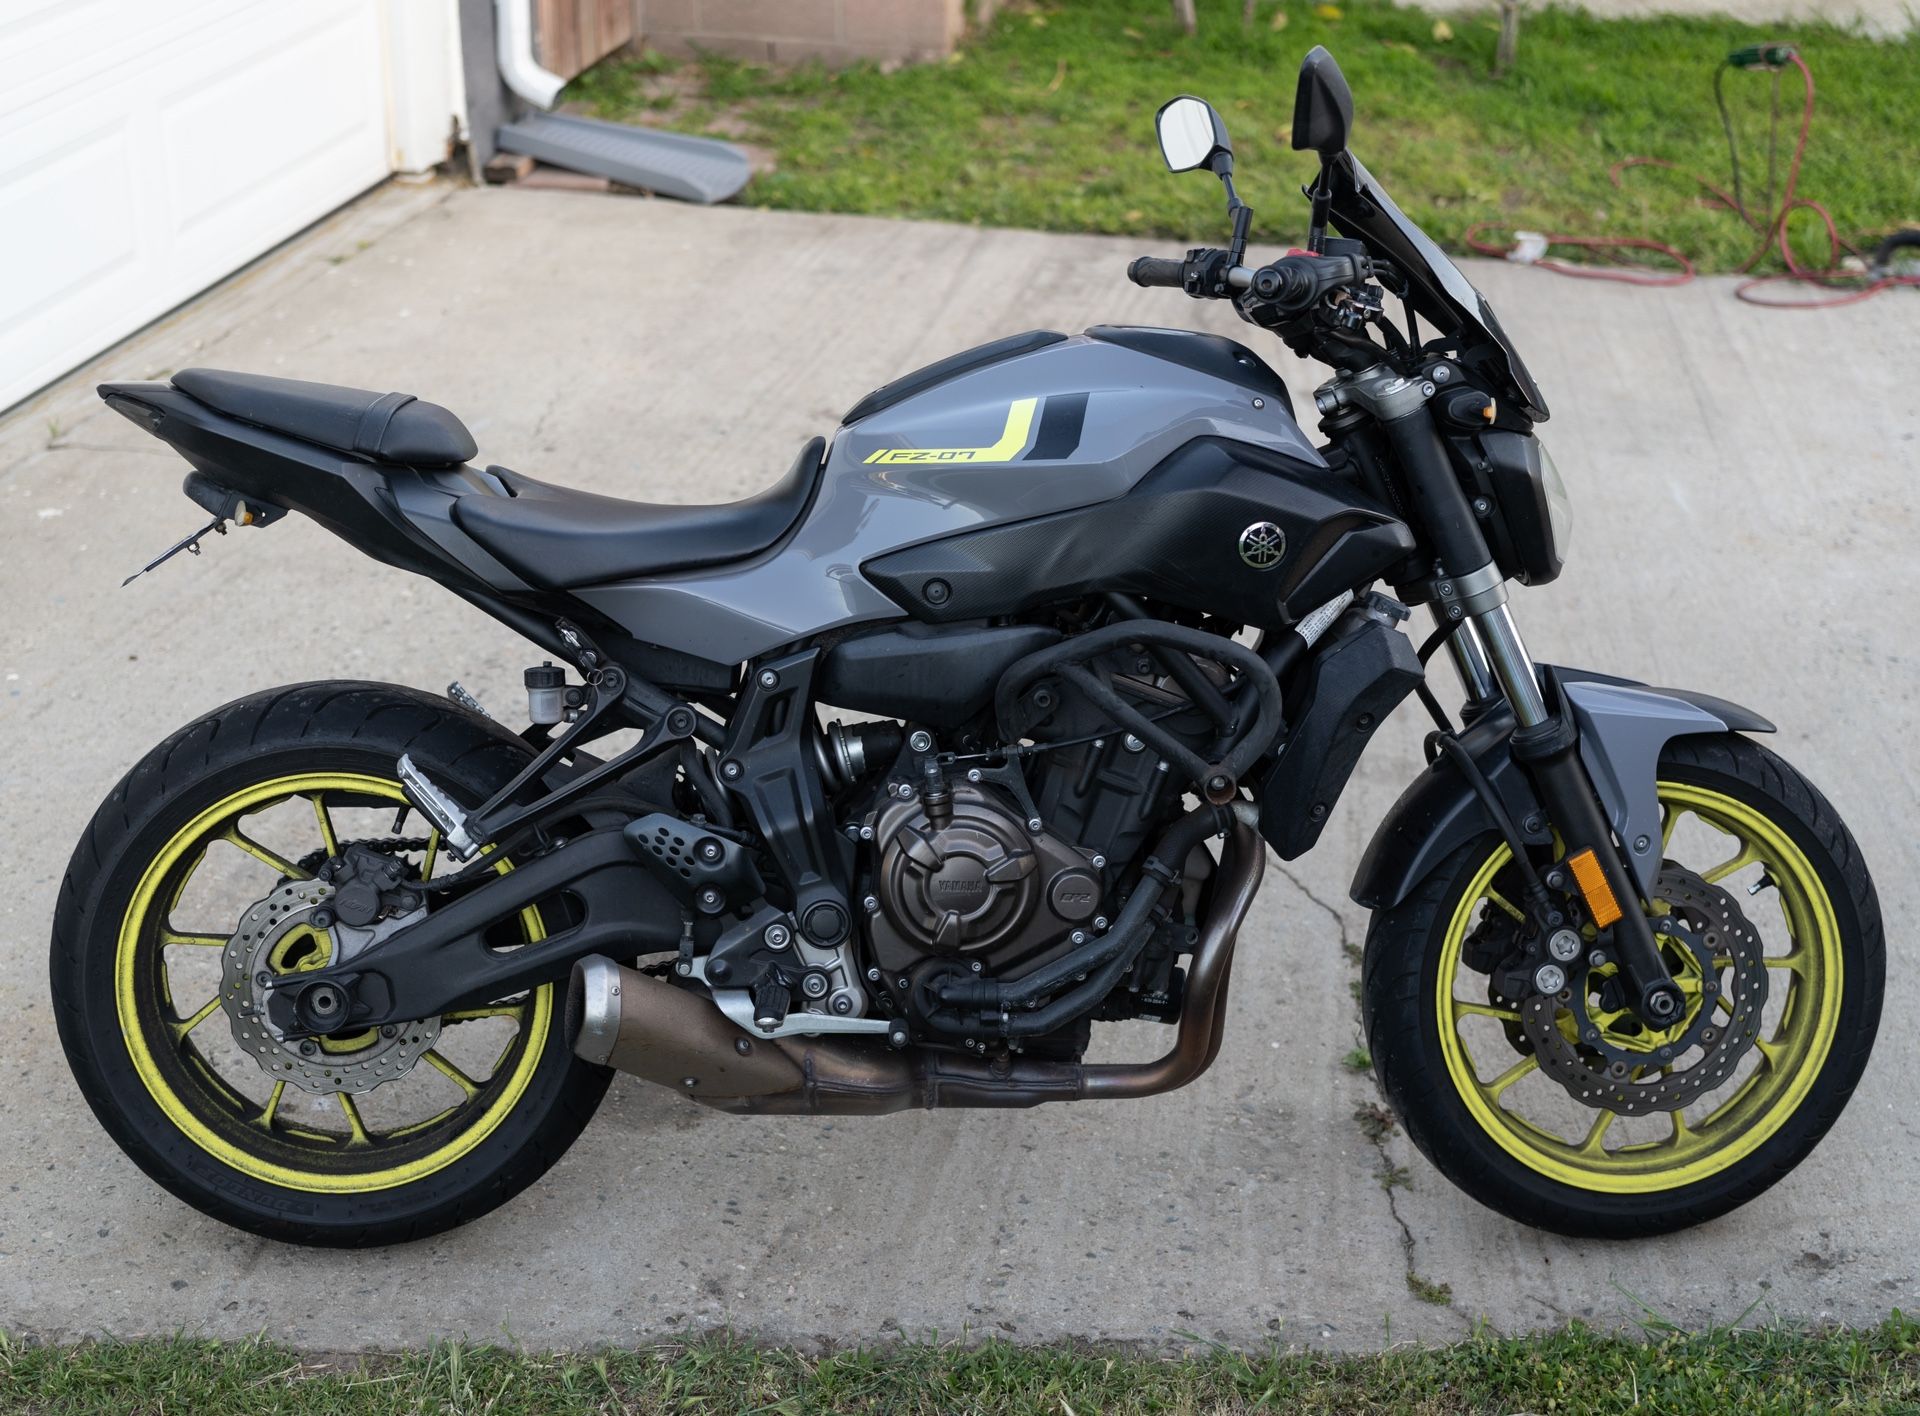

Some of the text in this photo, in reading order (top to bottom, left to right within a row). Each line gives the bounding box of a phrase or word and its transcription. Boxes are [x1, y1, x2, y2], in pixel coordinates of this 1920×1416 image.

[889, 451, 976, 461] FZ-07
[938, 880, 983, 892] YAMAHA
[194, 1166, 291, 1211] DUNLOP
